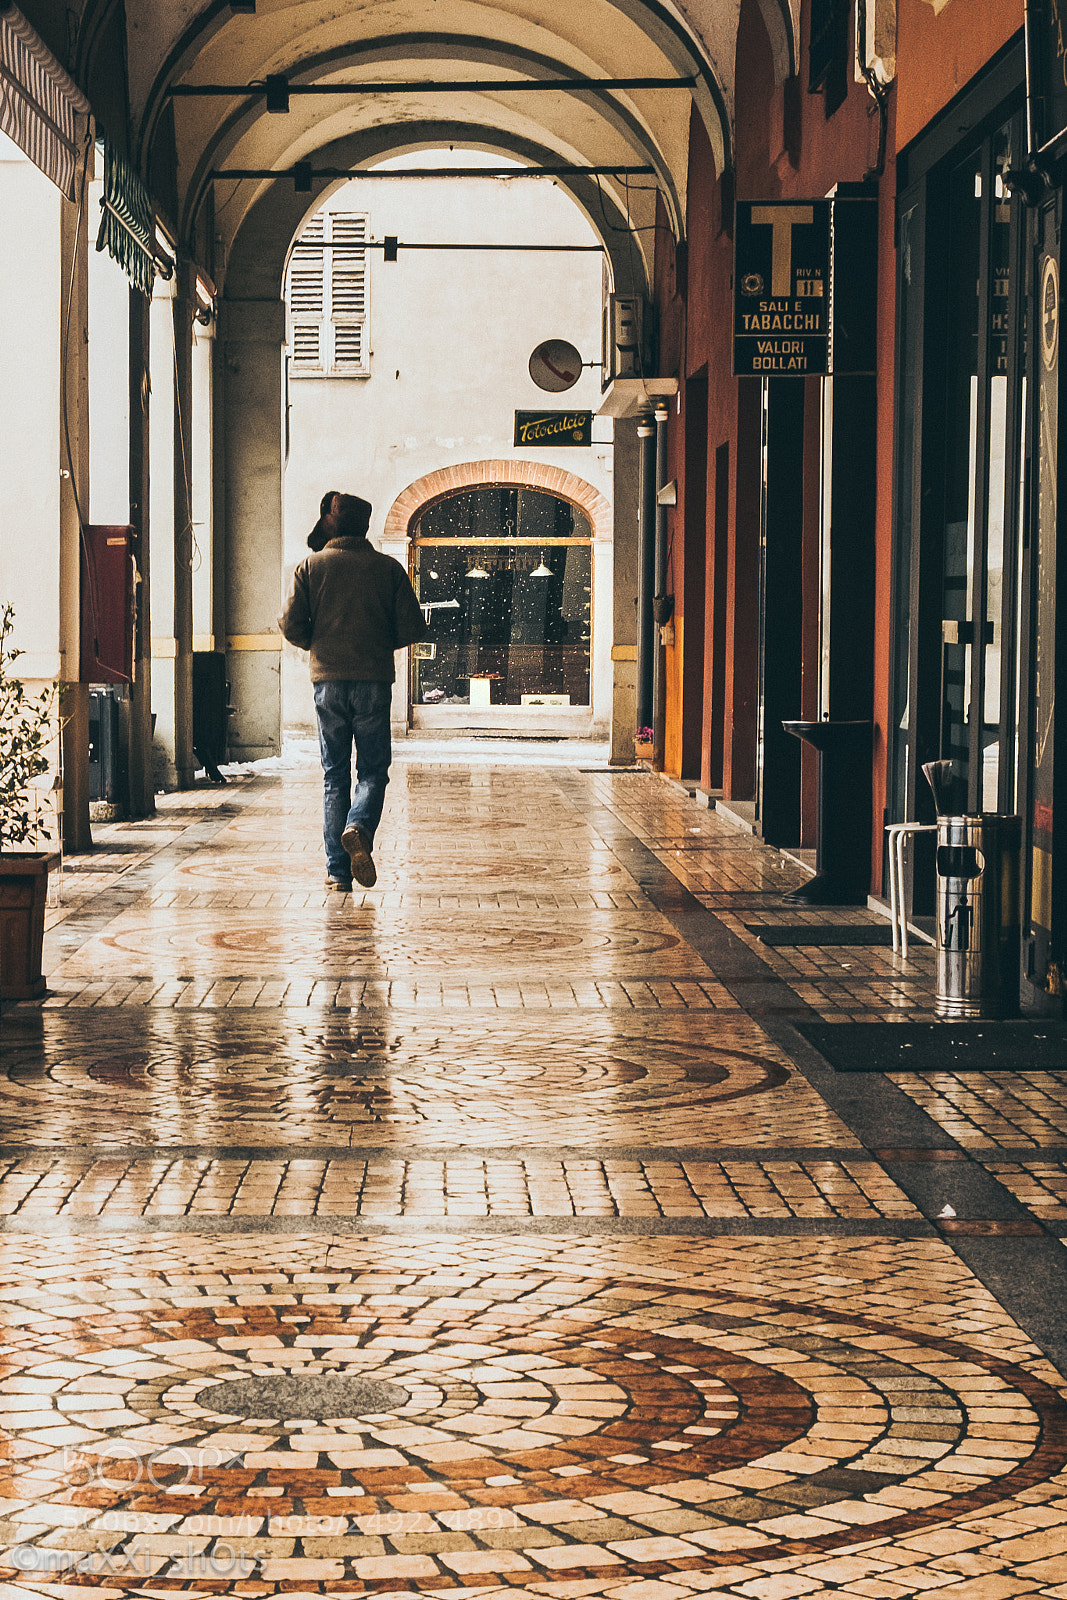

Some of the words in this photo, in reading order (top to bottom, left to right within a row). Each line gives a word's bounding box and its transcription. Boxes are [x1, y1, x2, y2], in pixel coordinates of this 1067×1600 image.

[751, 205, 814, 297] T
[759, 301, 789, 312] SALI
[794, 301, 802, 312] E
[742, 314, 820, 330] TABACCHI
[757, 341, 804, 353] VALORI
[752, 356, 807, 369] BOLLATI
[520, 413, 586, 442] Totocalcio
